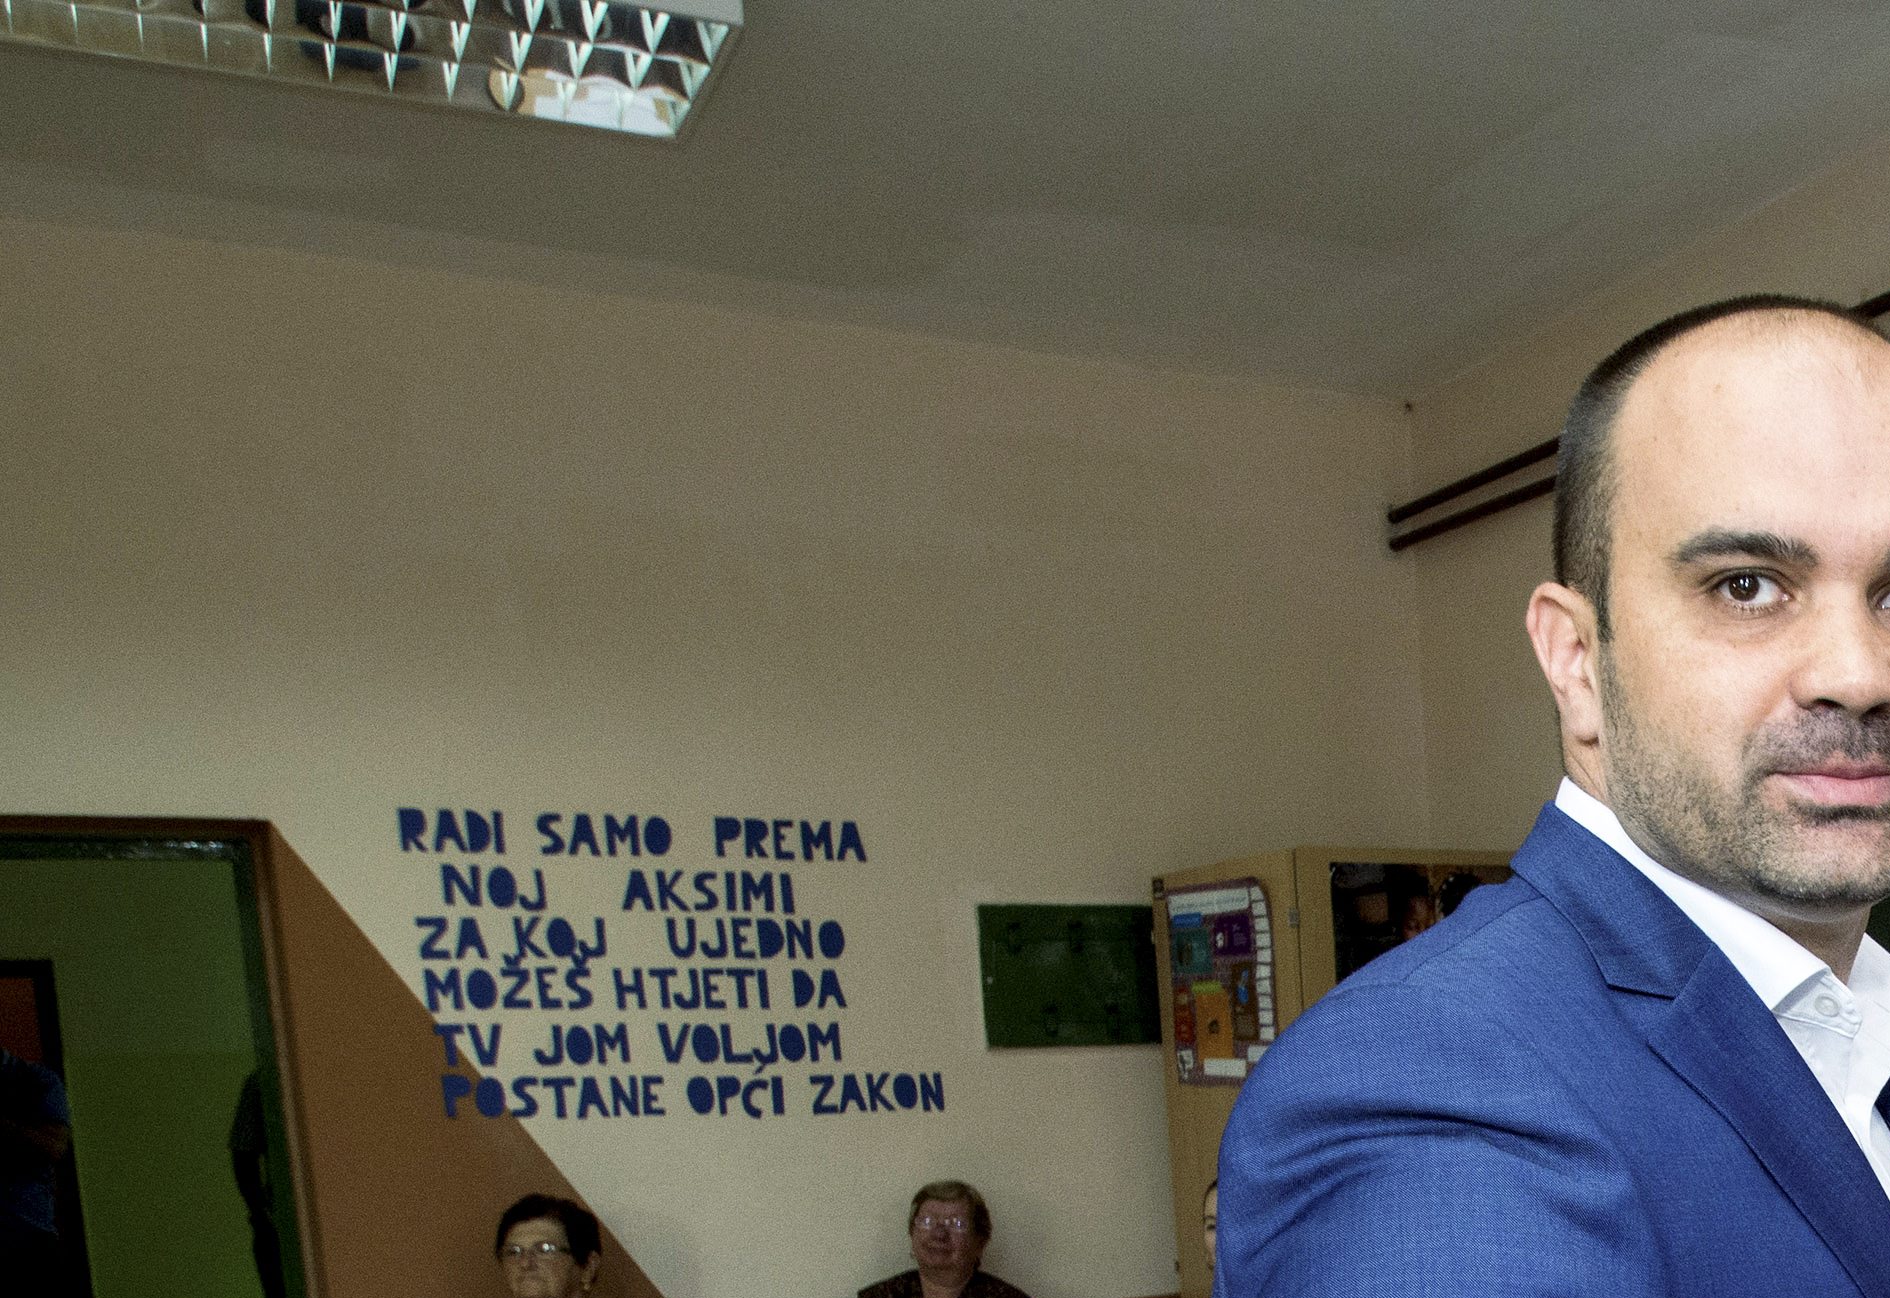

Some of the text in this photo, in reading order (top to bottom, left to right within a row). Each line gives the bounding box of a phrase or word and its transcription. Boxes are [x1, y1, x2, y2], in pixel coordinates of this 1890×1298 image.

[397, 808, 865, 861] RADI SAMO PREMA
[440, 864, 794, 914] NOJ AKSIMI
[414, 916, 845, 960] ZA KOJ UJEDNO
[422, 952, 846, 1011] MOŽEŠ HTJETI DA
[656, 1022, 842, 1065] VOLJOM
[442, 1075, 665, 1119] POSTANE
[809, 1072, 945, 1115] ZAKON
